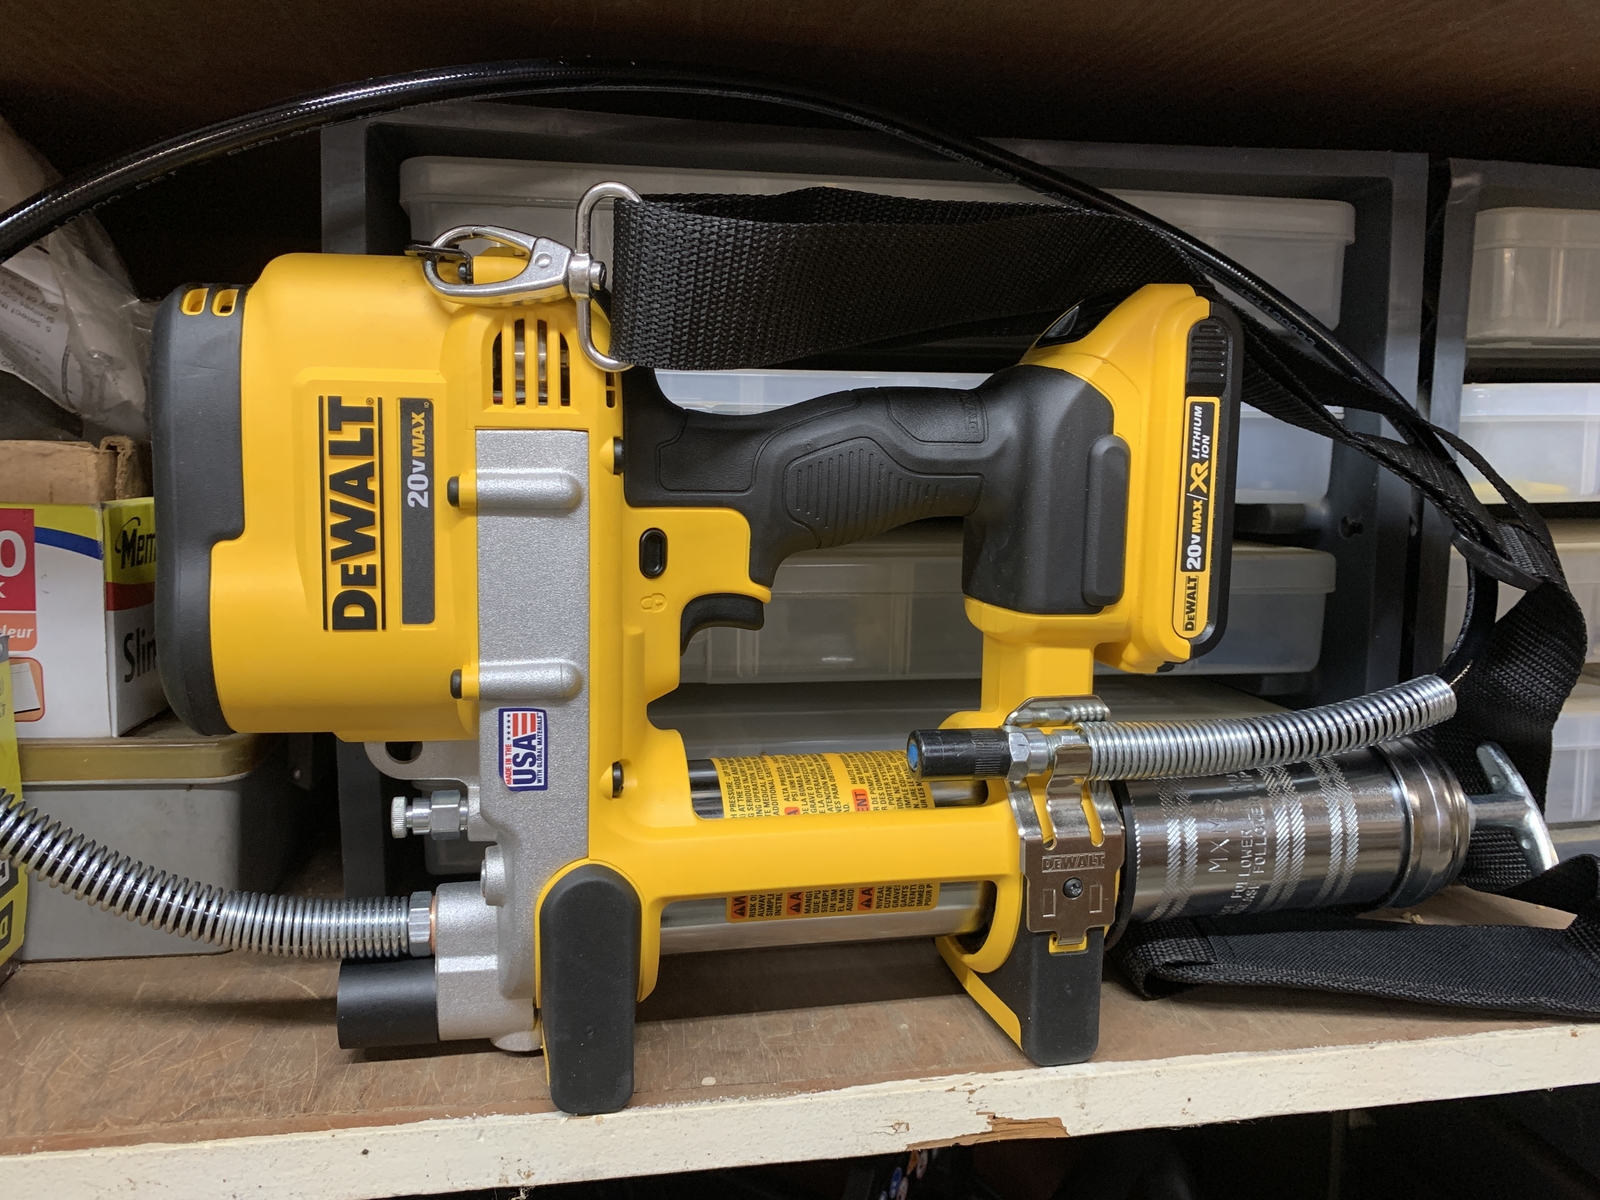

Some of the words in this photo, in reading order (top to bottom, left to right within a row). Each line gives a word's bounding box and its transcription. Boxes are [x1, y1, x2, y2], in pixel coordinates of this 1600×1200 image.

[411, 411, 425, 457] MAX
[1192, 405, 1203, 459] LITHIUM
[1201, 435, 1210, 458] ION
[328, 396, 377, 631] DEWALT
[1192, 500, 1203, 533] MAX
[1184, 576, 1197, 631] DEWALT
[513, 733, 536, 784] USA
[731, 767, 739, 775] AND
[847, 769, 857, 784] HAUTE
[854, 764, 862, 774] BARS
[869, 763, 883, 790] DOMMAGES
[733, 776, 742, 789] HOSE
[889, 774, 898, 784] PAS
[726, 782, 737, 812] PRESSURE
[735, 791, 744, 802] THE
[744, 785, 753, 811] SERIOUS
[759, 782, 770, 808] MEDICAL
[768, 779, 779, 816] ADDITIONAL
[782, 787, 790, 801] ALTA
[831, 784, 839, 799] PARA
[884, 782, 895, 805] PORTER
[909, 788, 918, 800] LIRE
[917, 788, 925, 798] LES
[800, 798, 808, 806] LA
[808, 792, 817, 813] GRAVE
[816, 800, 825, 808] LA
[872, 796, 878, 804] DE
[738, 804, 745, 812] AT
[1042, 854, 1105, 871] DEWALT
[900, 886, 908, 907] GANTS
[924, 890, 932, 905] POUR
[812, 901, 820, 913] QUE
[829, 903, 836, 912] UN
